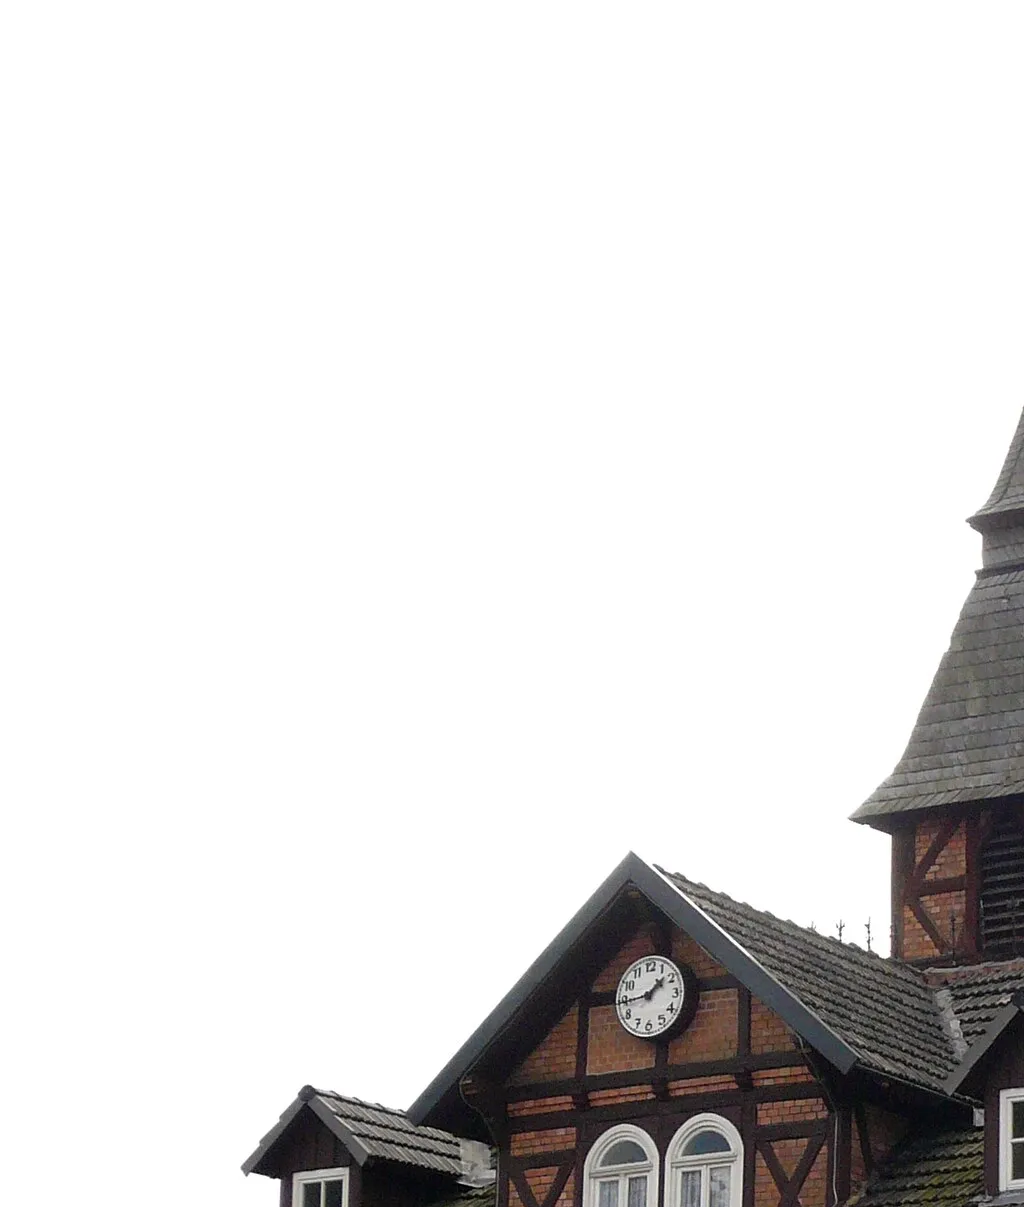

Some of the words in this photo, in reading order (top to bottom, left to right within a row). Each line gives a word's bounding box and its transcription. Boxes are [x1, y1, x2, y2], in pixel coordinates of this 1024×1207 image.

[645, 961, 656, 973] 12
[660, 963, 665, 974] 1
[634, 967, 641, 979] 11
[667, 972, 675, 983] 2
[624, 980, 635, 991] 10
[672, 987, 679, 998] 3
[666, 1001, 675, 1013] 4
[625, 1008, 631, 1019] 8
[635, 1018, 641, 1029] 7
[645, 1019, 653, 1031] 6
[658, 1014, 666, 1025] 5
